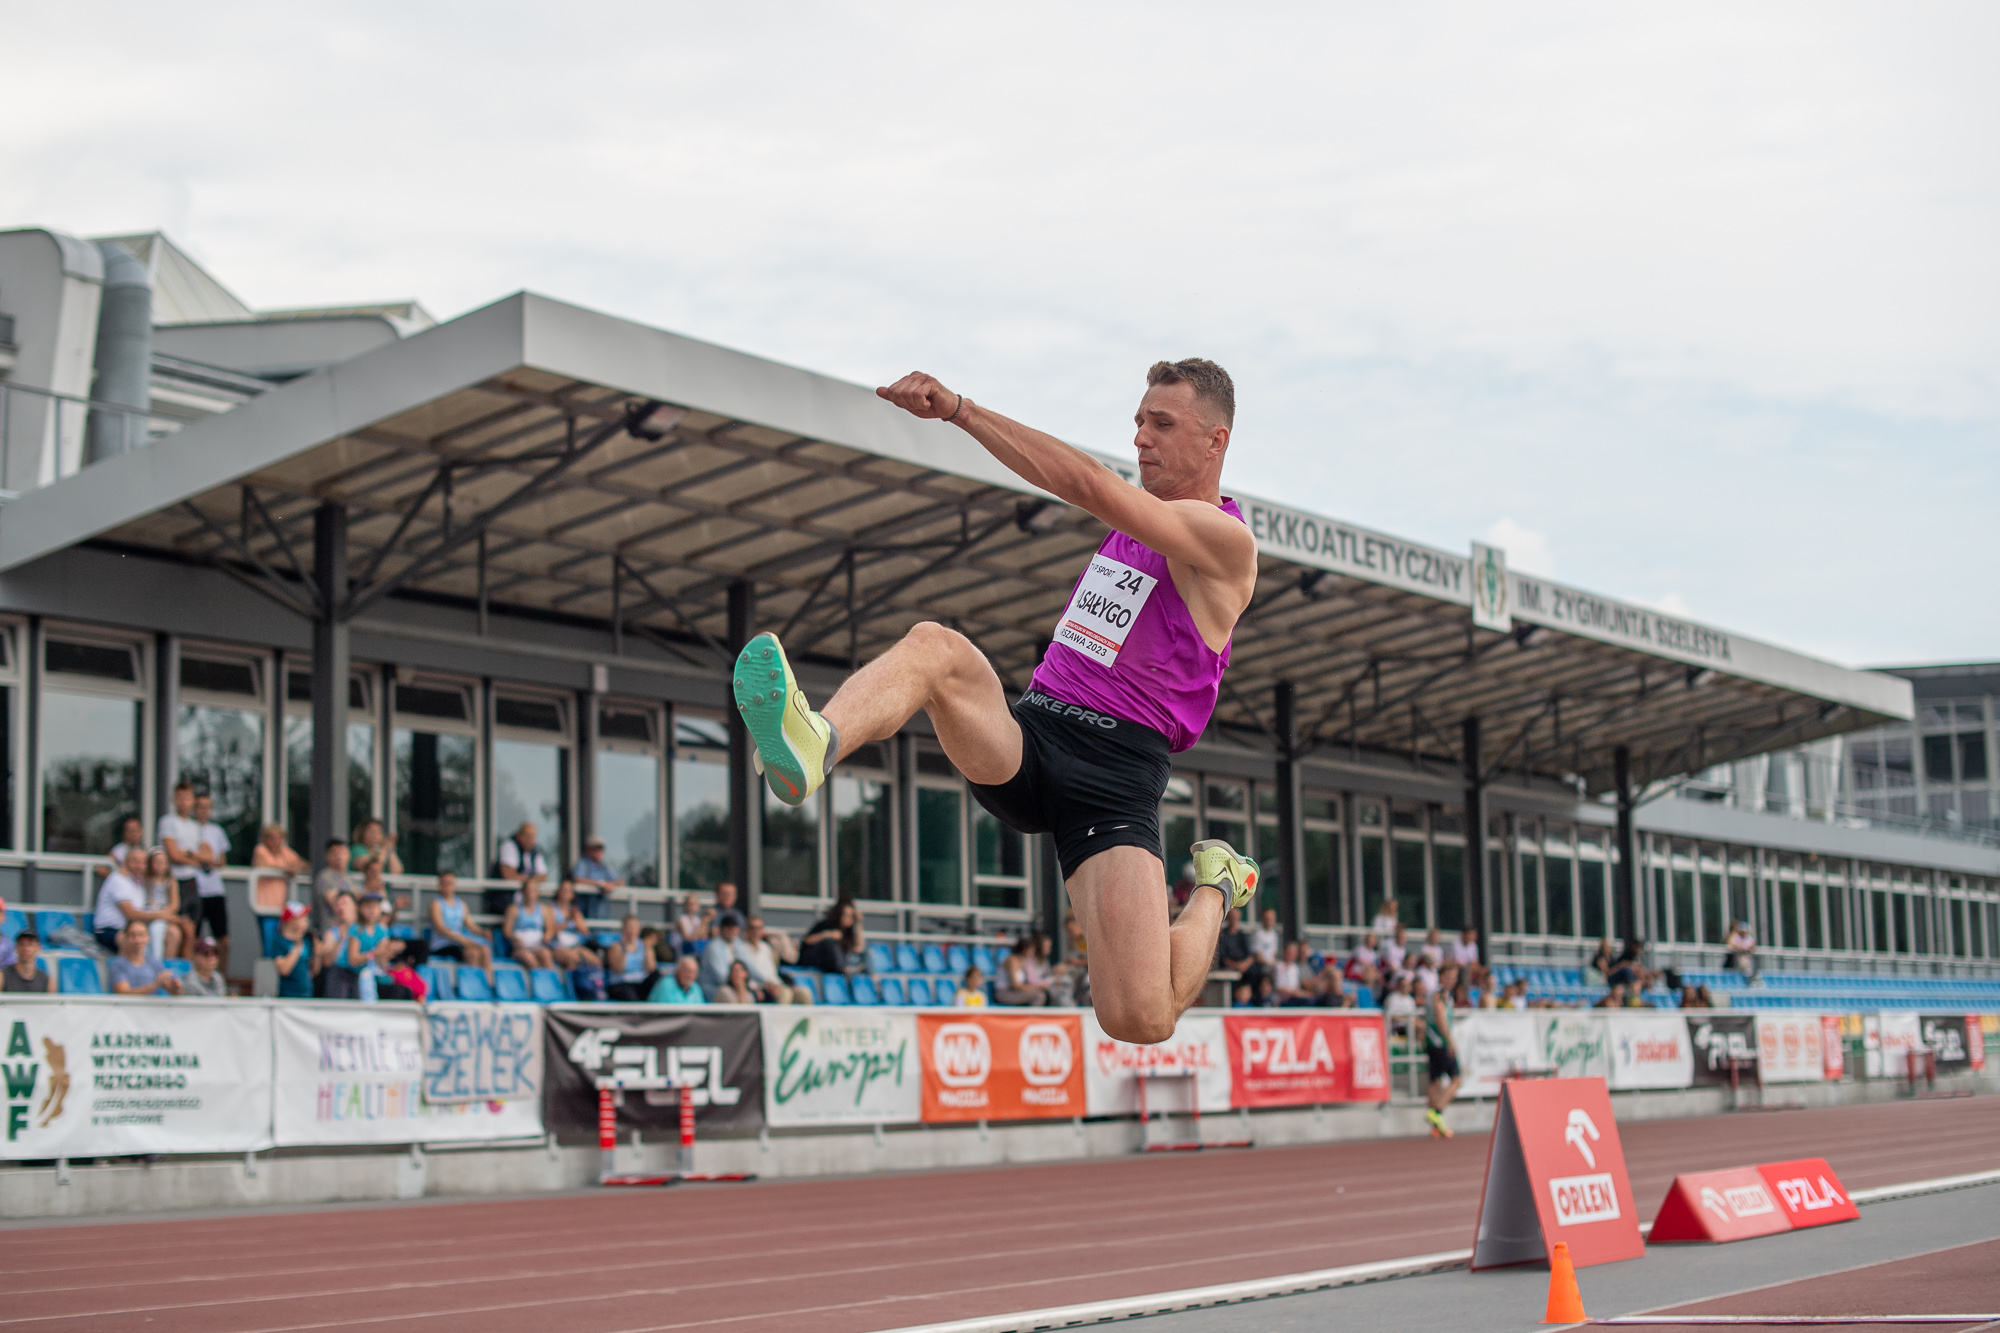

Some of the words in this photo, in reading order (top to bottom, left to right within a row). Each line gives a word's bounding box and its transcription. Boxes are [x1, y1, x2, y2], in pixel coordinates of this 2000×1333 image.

[1237, 503, 1464, 592] EKKOATLETYCZNY
[1096, 565, 1116, 578] SPORT
[1115, 570, 1144, 595] 24
[1552, 589, 1651, 641] ZYGMUNTA
[1655, 616, 1732, 661] SZELESTA
[1086, 641, 1107, 657] 2023
[1025, 691, 1067, 713] NIKE
[1063, 705, 1118, 729] PRO
[427, 1011, 533, 1051] DAWAJ
[568, 1027, 621, 1070] 4F
[819, 1028, 888, 1046] INTER
[1241, 1027, 1335, 1075] PZLA
[2, 1021, 40, 1142] AWF
[1558, 1182, 1613, 1216] ORLEN
[1776, 1175, 1845, 1213] PZLA
